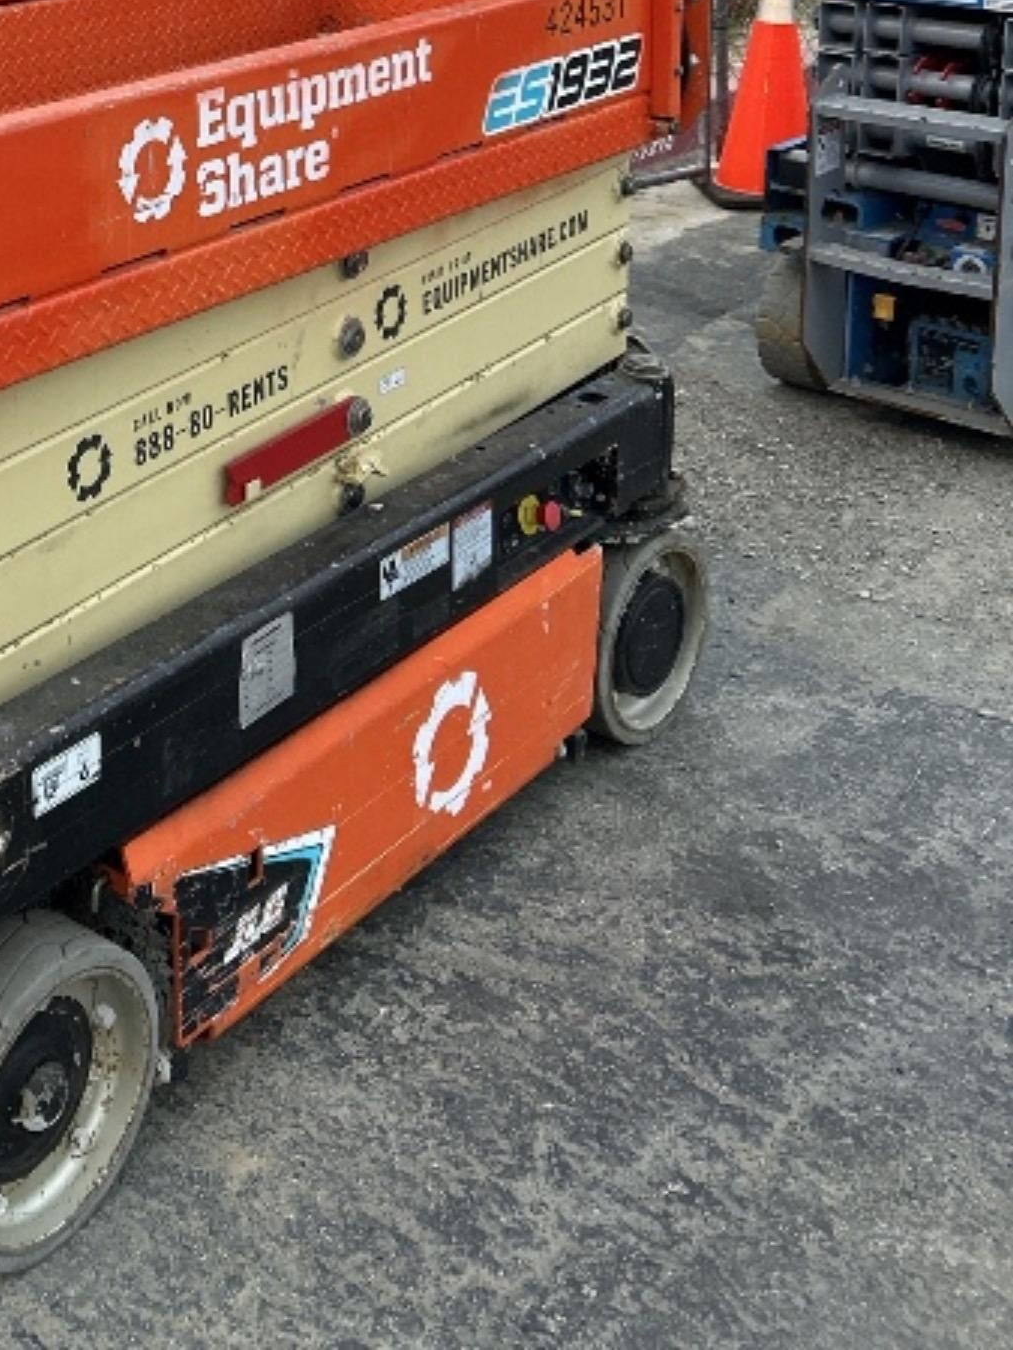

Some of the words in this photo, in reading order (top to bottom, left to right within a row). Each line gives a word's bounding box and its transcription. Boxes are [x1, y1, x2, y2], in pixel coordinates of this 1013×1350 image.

[196, 37, 433, 149] Equipment
[482, 33, 643, 135] ES1932
[196, 140, 330, 218] Share
[421, 209, 589, 316] EQUIPMENTSHARE.COM
